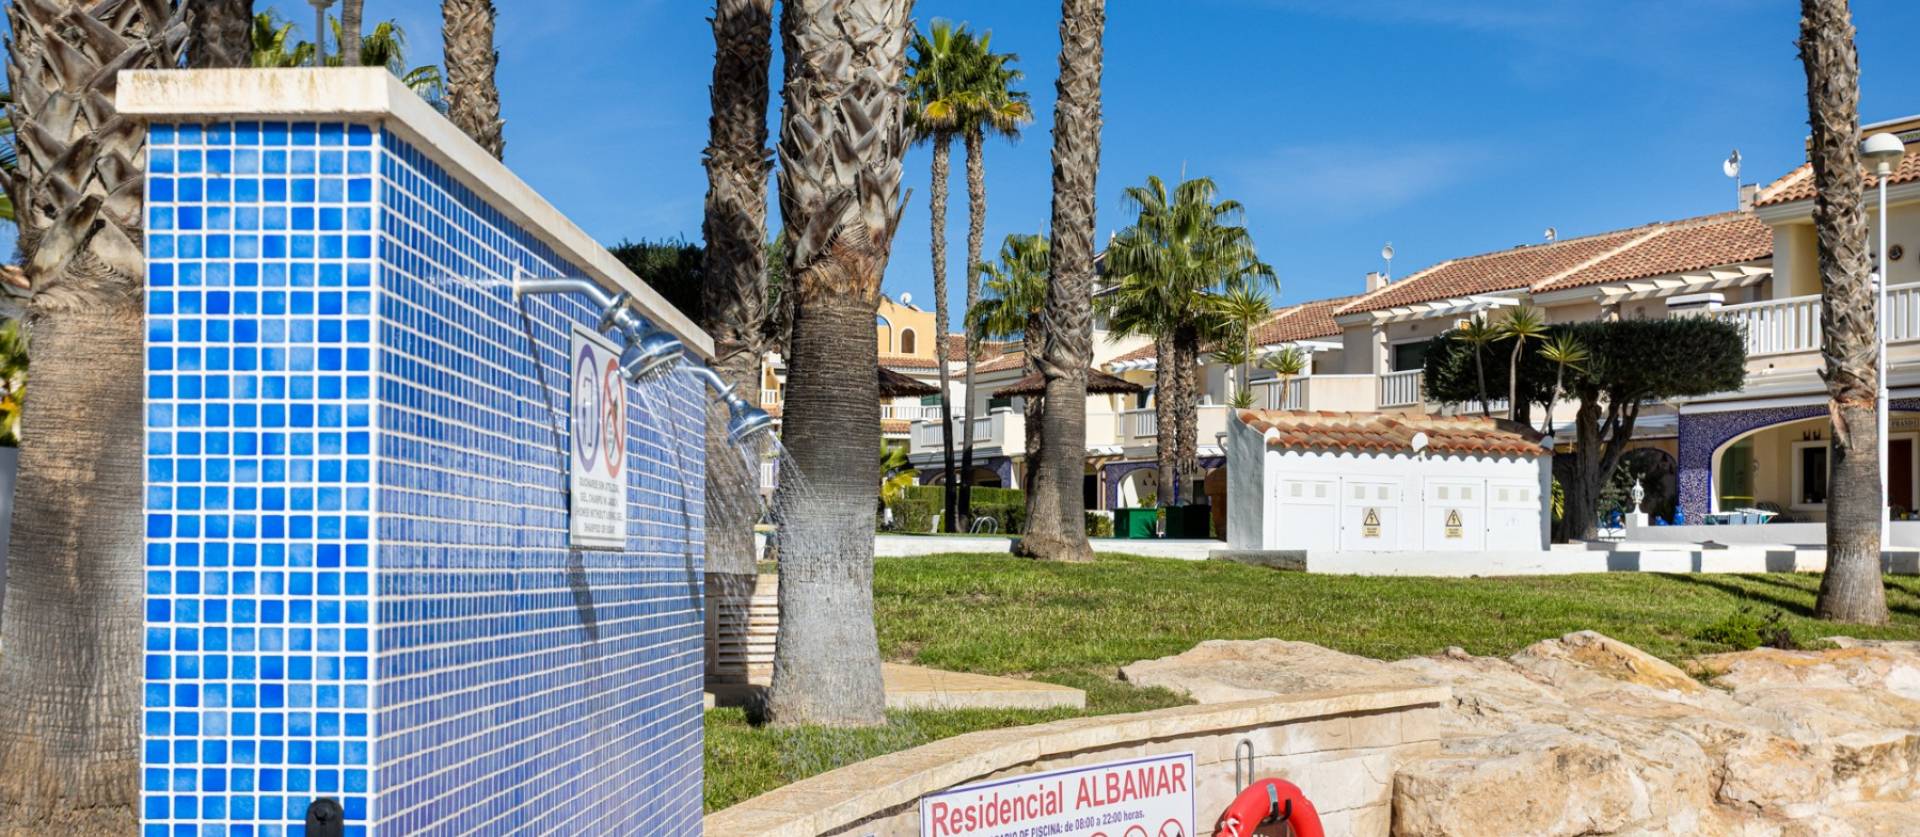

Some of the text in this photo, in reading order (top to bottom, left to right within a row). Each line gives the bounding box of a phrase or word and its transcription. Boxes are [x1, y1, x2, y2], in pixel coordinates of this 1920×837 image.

[931, 763, 1187, 837] Residencial ALBAMAR
[1031, 823, 1063, 837] PISCINA:
[1065, 821, 1074, 832] de
[1076, 816, 1095, 830] 08:00
[1096, 817, 1101, 826] a
[1102, 811, 1122, 825] 22:00
[1124, 810, 1145, 821] horas.
